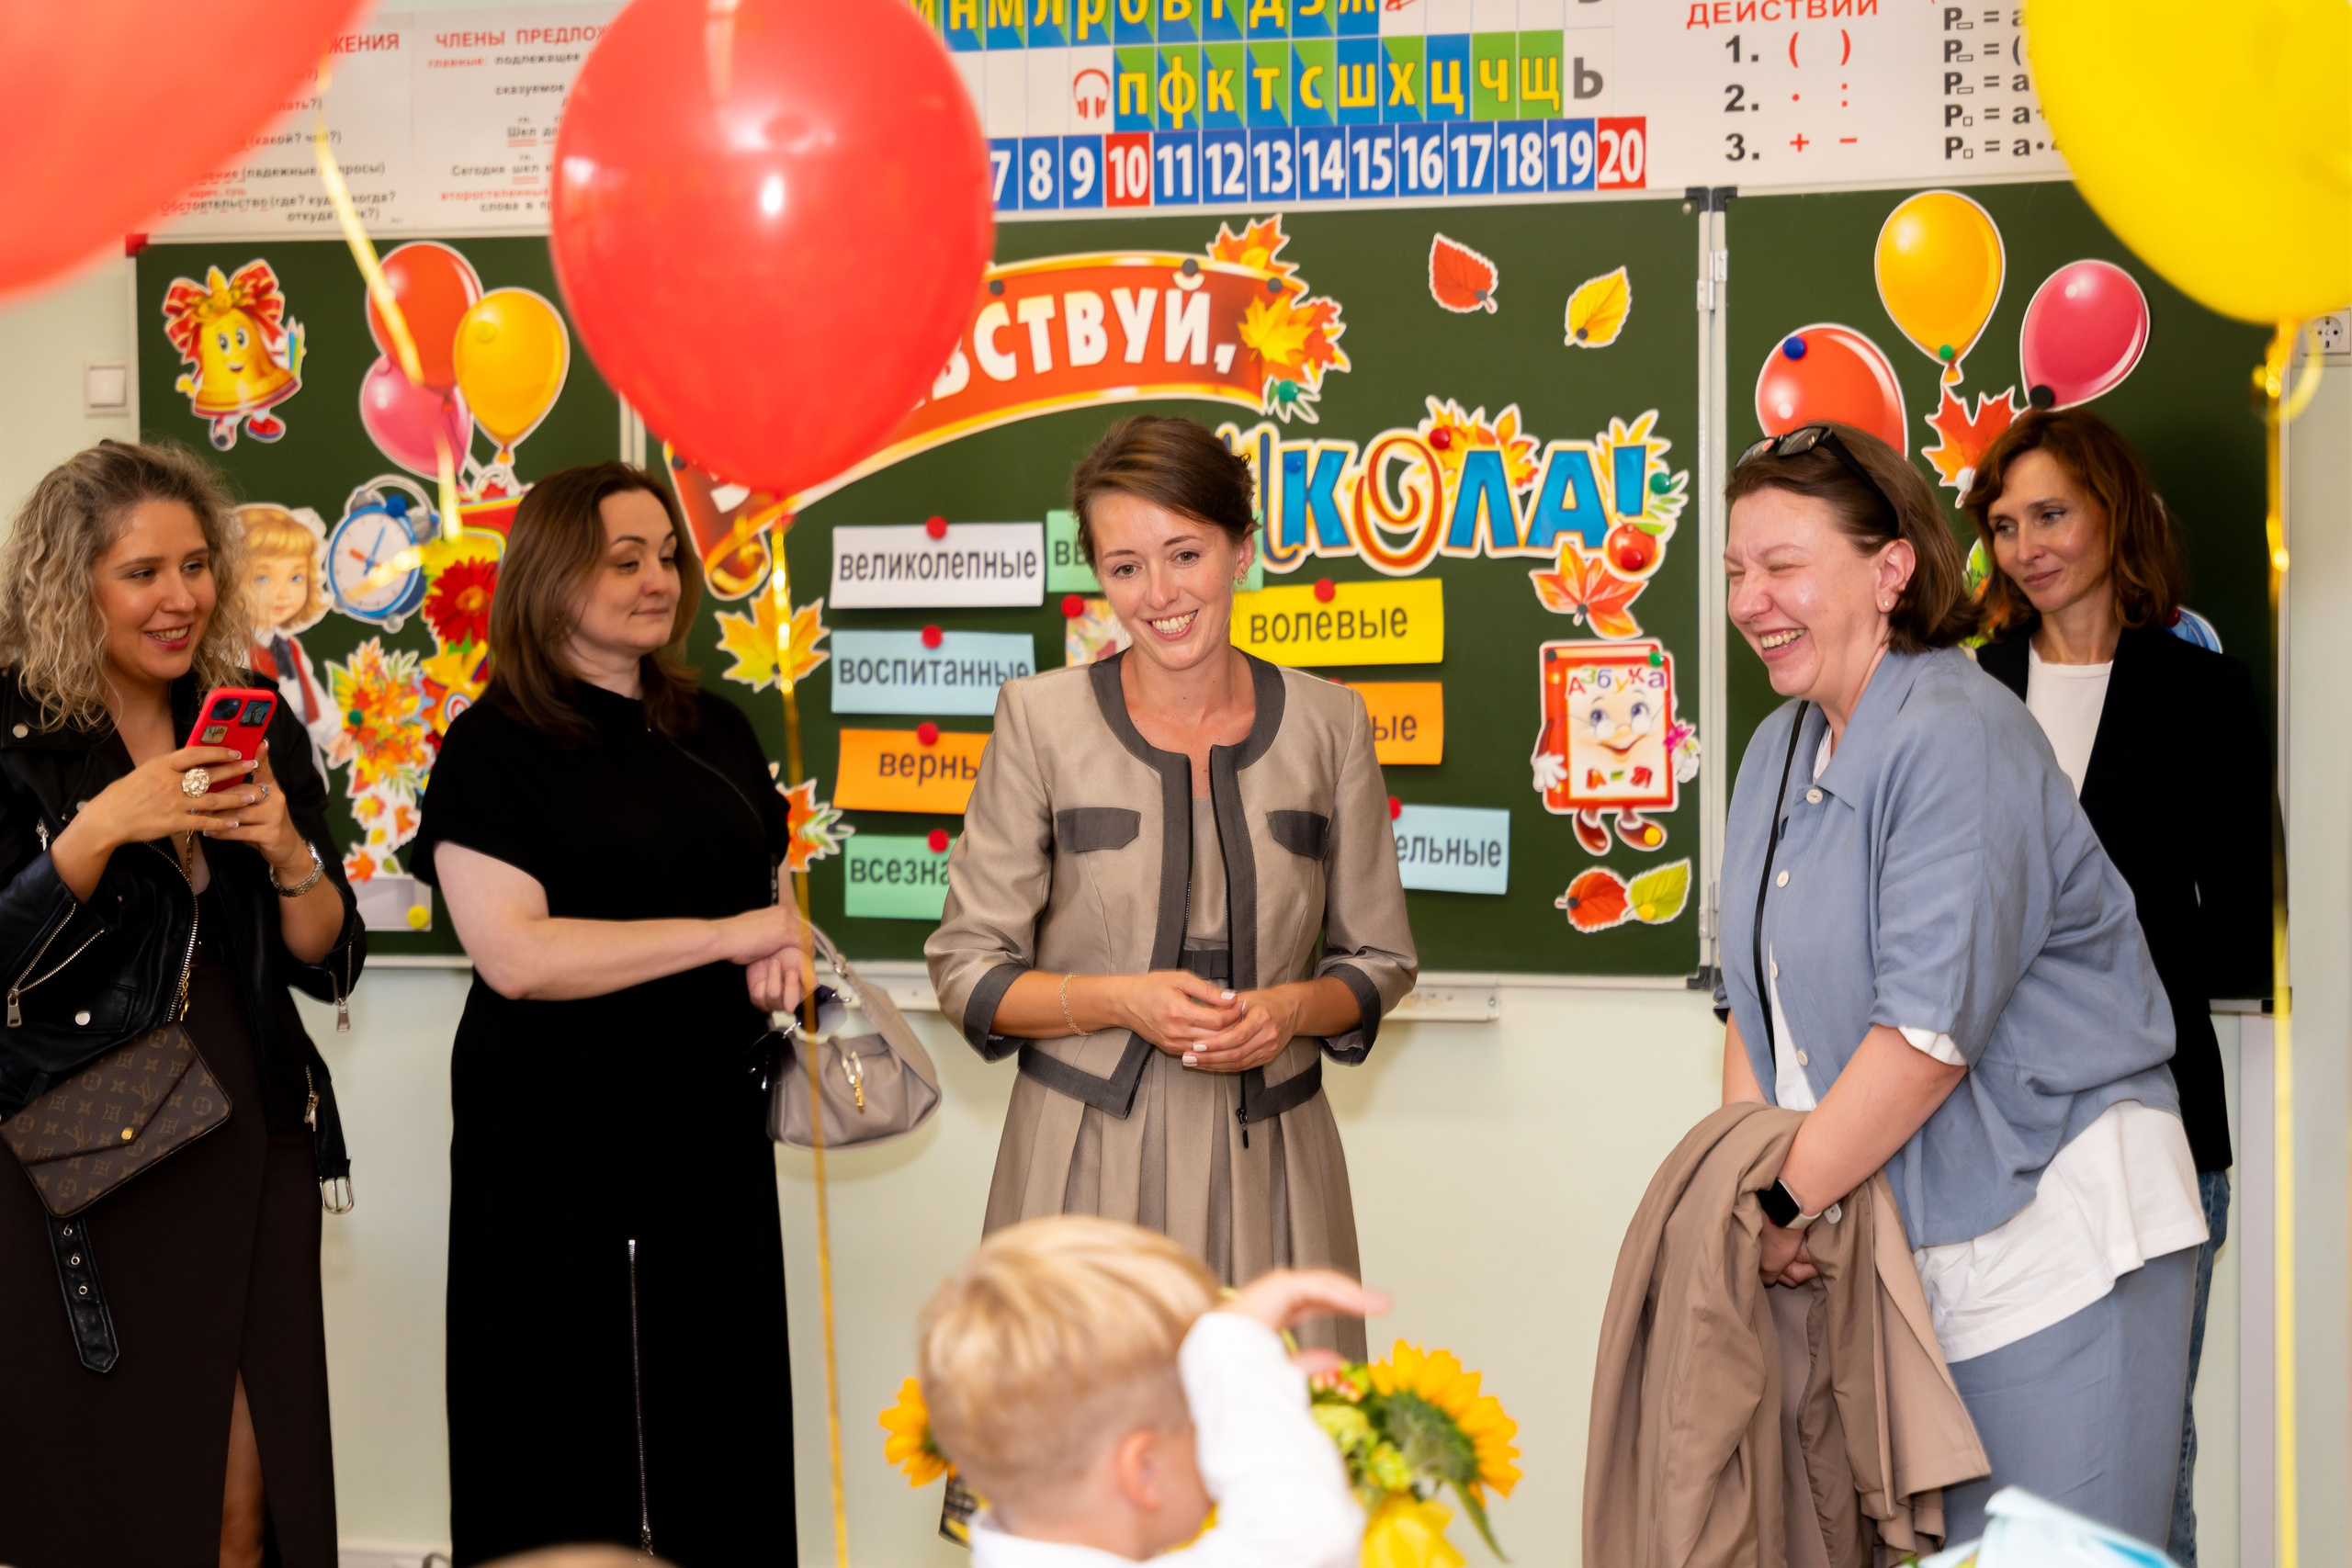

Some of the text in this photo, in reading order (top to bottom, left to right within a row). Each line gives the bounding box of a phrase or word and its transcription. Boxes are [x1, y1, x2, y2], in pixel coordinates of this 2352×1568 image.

[435, 30, 505, 50] ЧЛЕНЫ
[990, 129, 1645, 202] 7 8 9 10 11 12 13 14 15 16 17 18 19 20
[839, 547, 1037, 581] великолепные
[1250, 606, 1408, 644] волевые
[839, 658, 1029, 687] воспитанные
